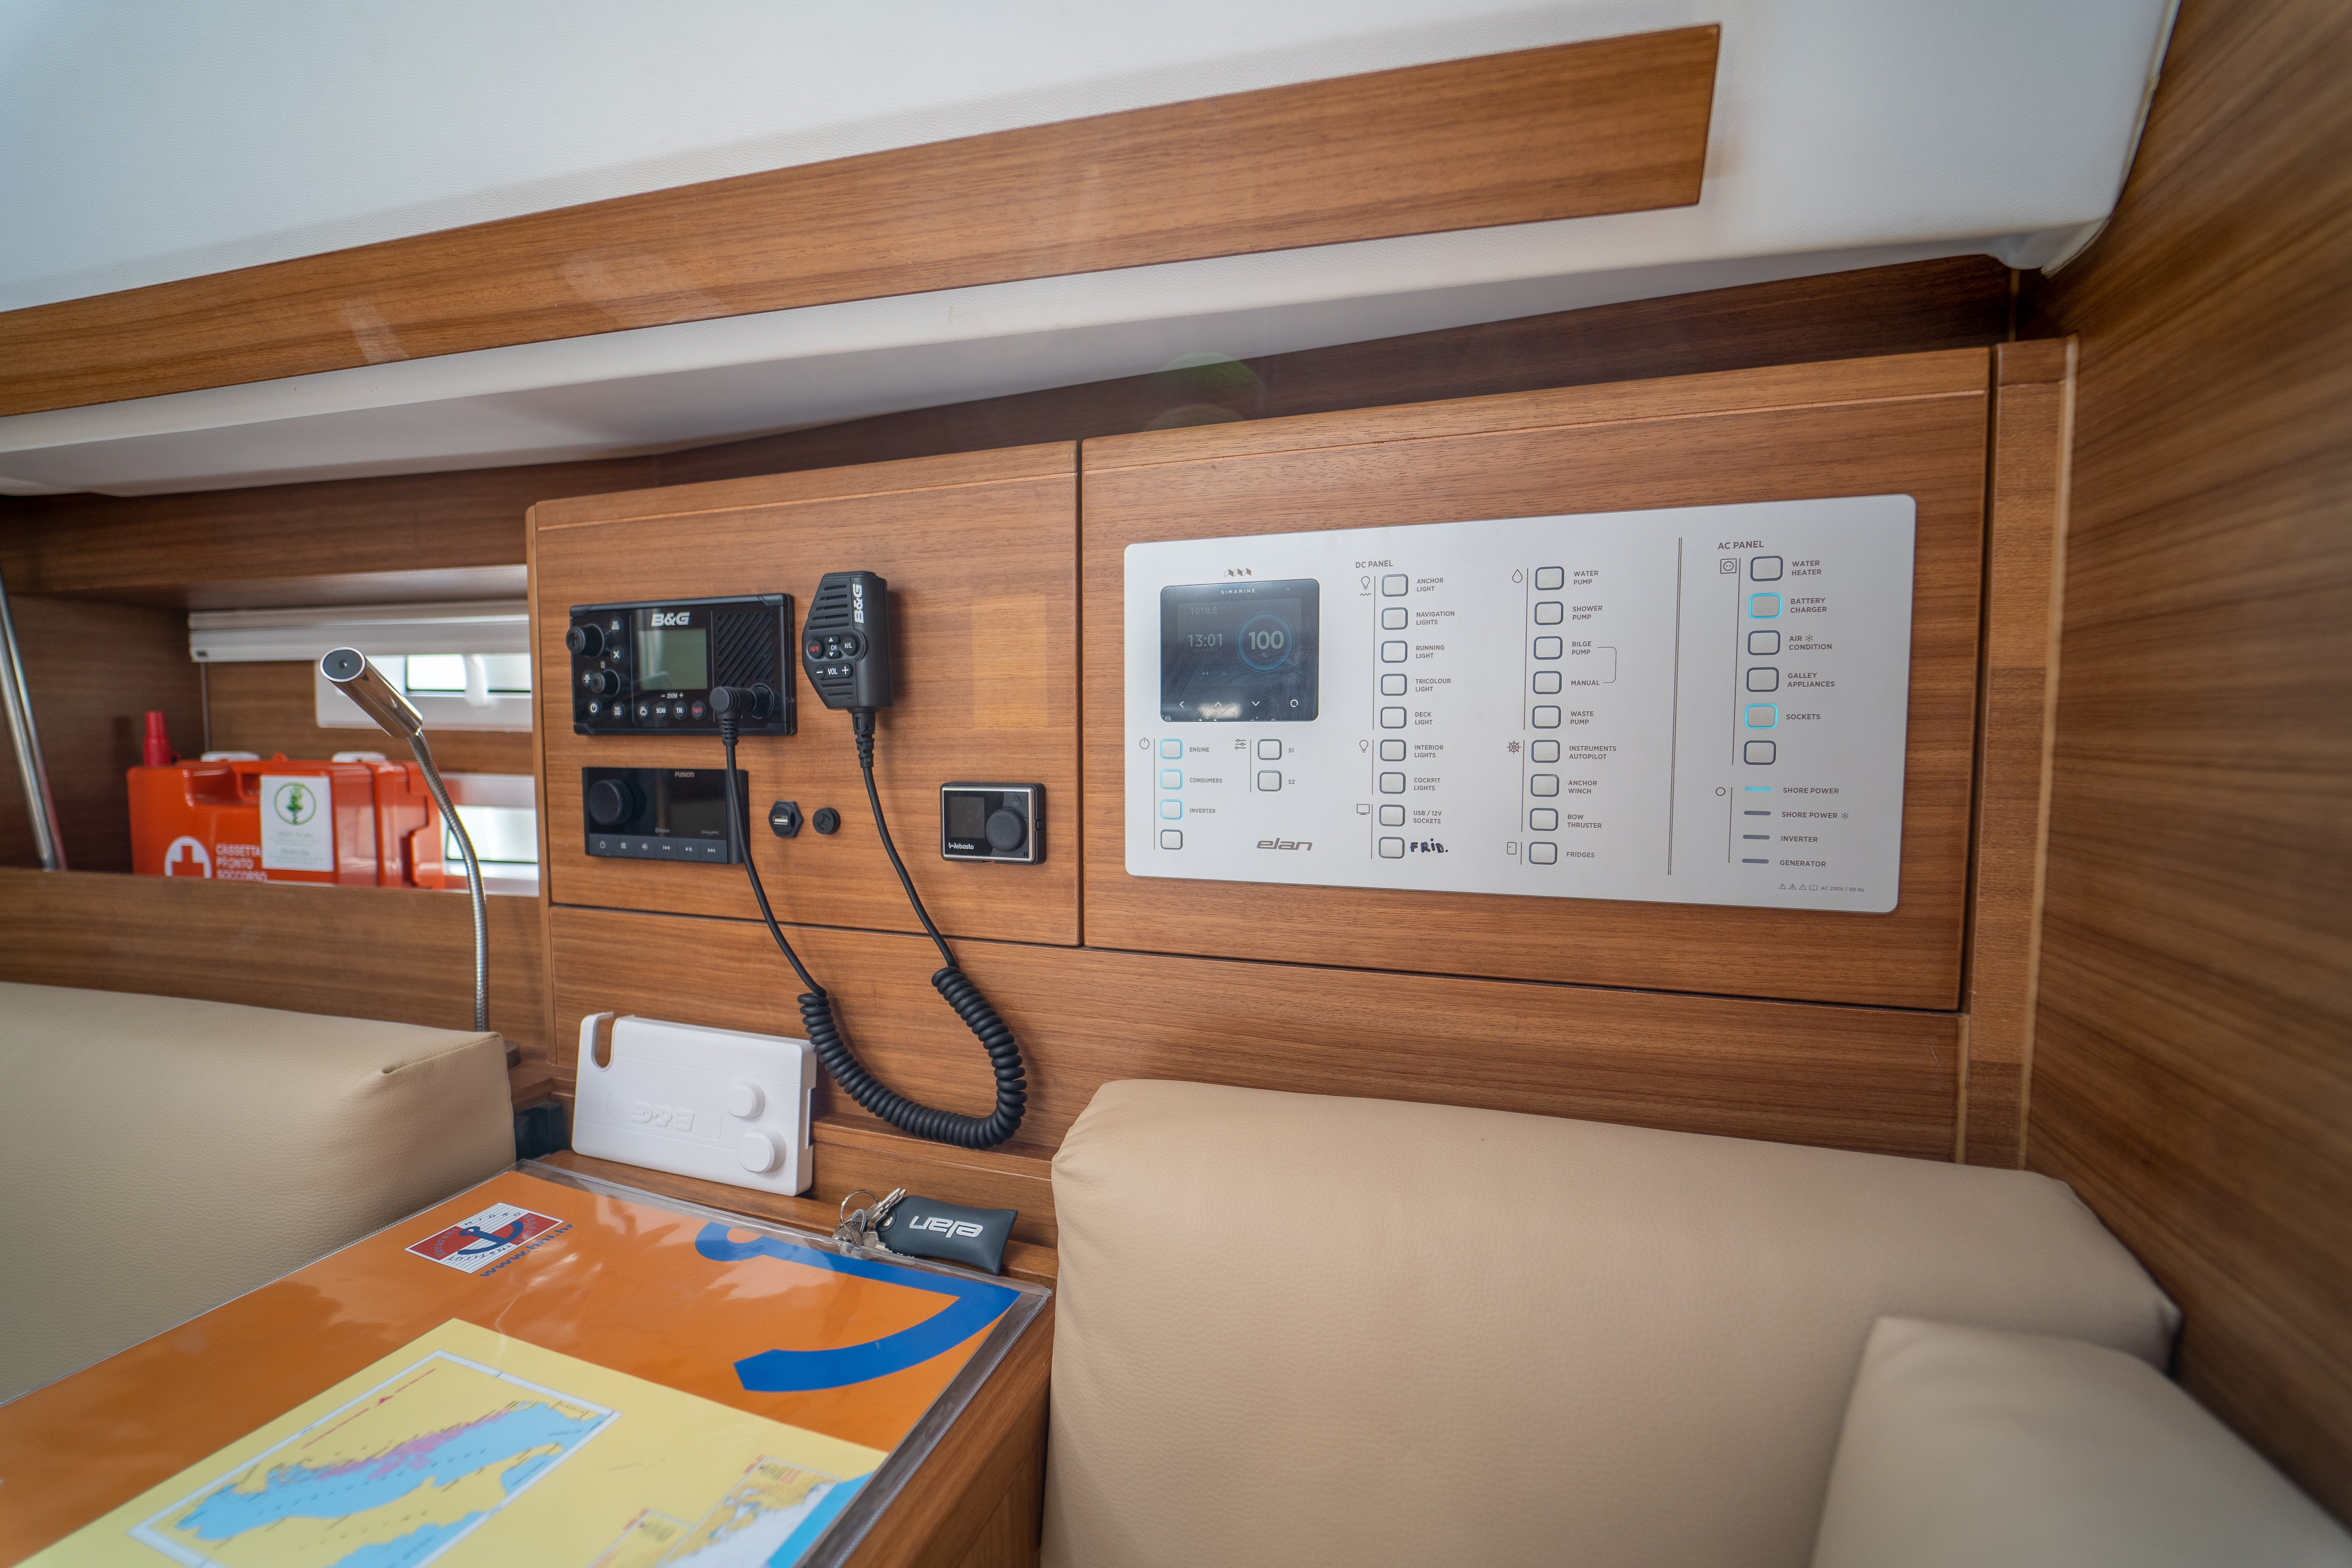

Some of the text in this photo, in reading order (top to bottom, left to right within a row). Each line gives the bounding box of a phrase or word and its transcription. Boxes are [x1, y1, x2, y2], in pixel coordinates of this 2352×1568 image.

[1717, 540, 1764, 550] AC PANEL
[852, 583, 864, 624] B&G
[1190, 607, 1217, 615] 1019.8
[651, 611, 691, 627] B&G
[1188, 633, 1222, 647] 13:01
[1249, 630, 1284, 650] 100
[1256, 838, 1313, 851] elan
[630, 1102, 695, 1132] B&G
[909, 1216, 983, 1238] elan
[448, 1245, 512, 1261] INSTITUT
[479, 1223, 573, 1277] www.hhi.hr
